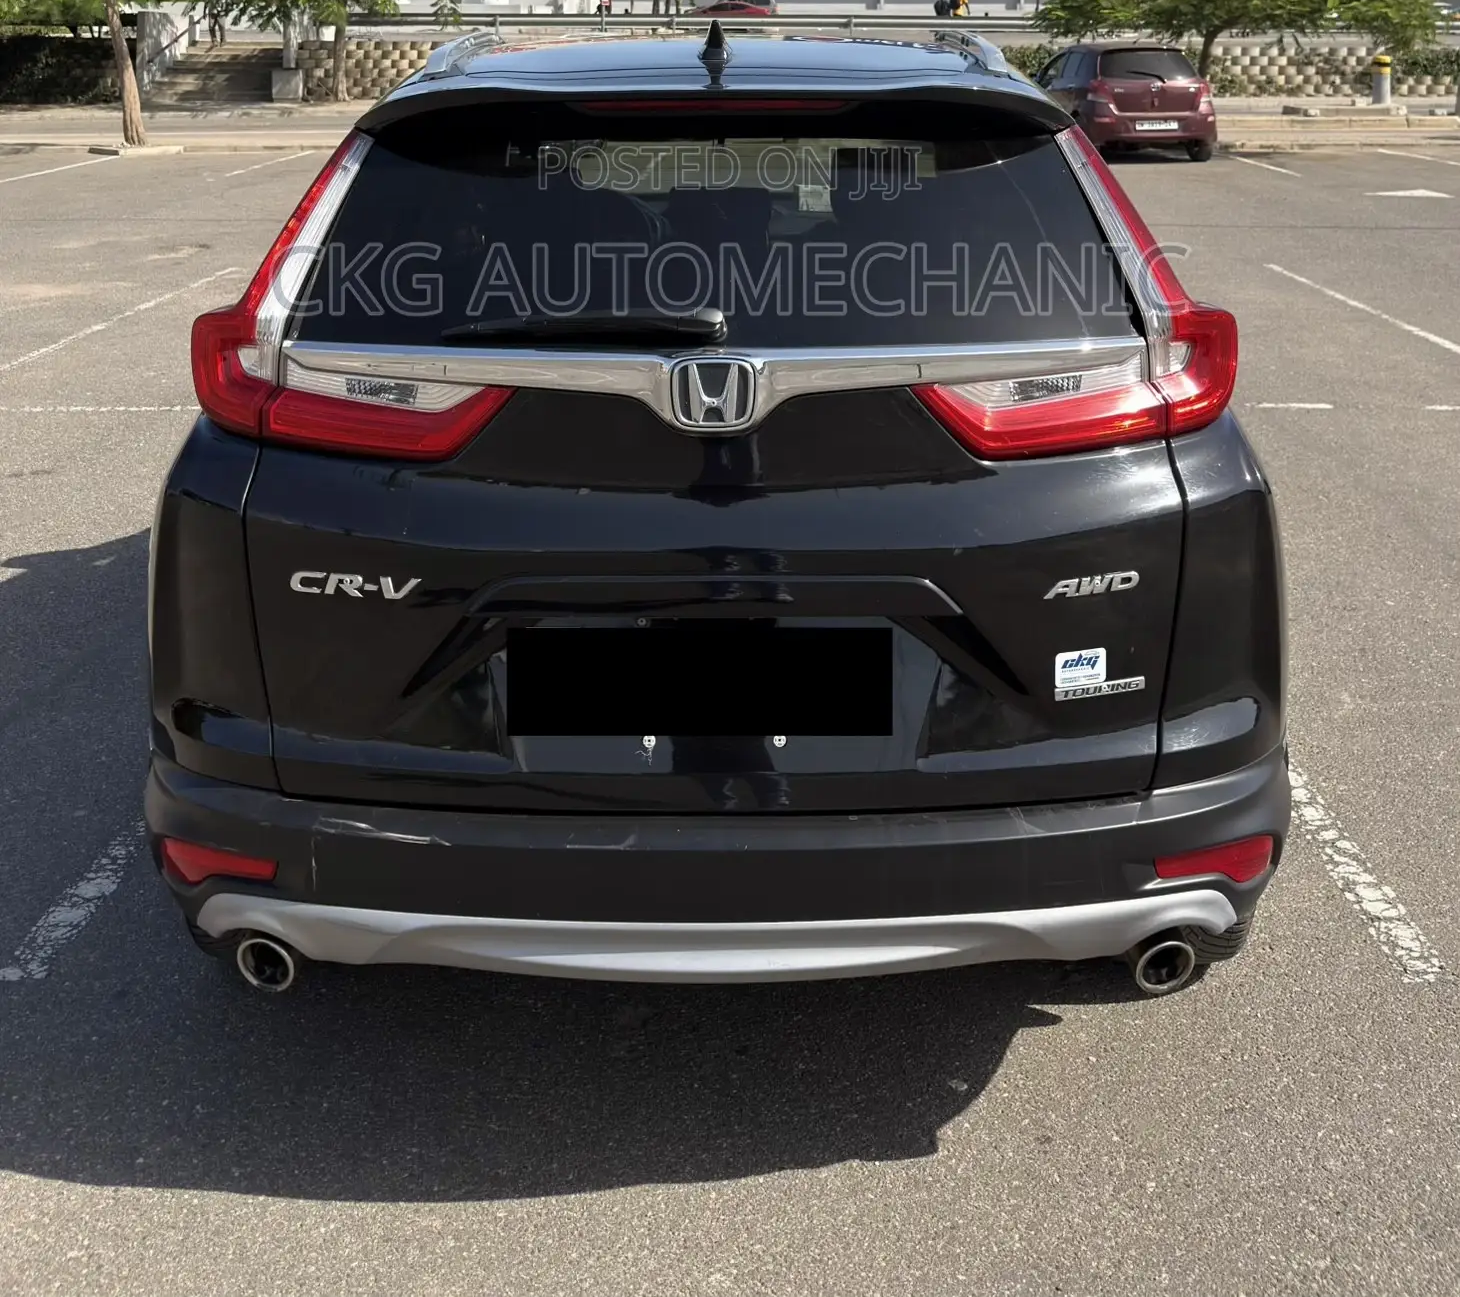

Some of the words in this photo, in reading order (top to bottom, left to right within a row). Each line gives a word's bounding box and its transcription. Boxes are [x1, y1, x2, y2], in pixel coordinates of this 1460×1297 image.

[289, 570, 423, 600] CR-V
[1043, 570, 1141, 600] AWD
[1060, 679, 1141, 700] TOURING
